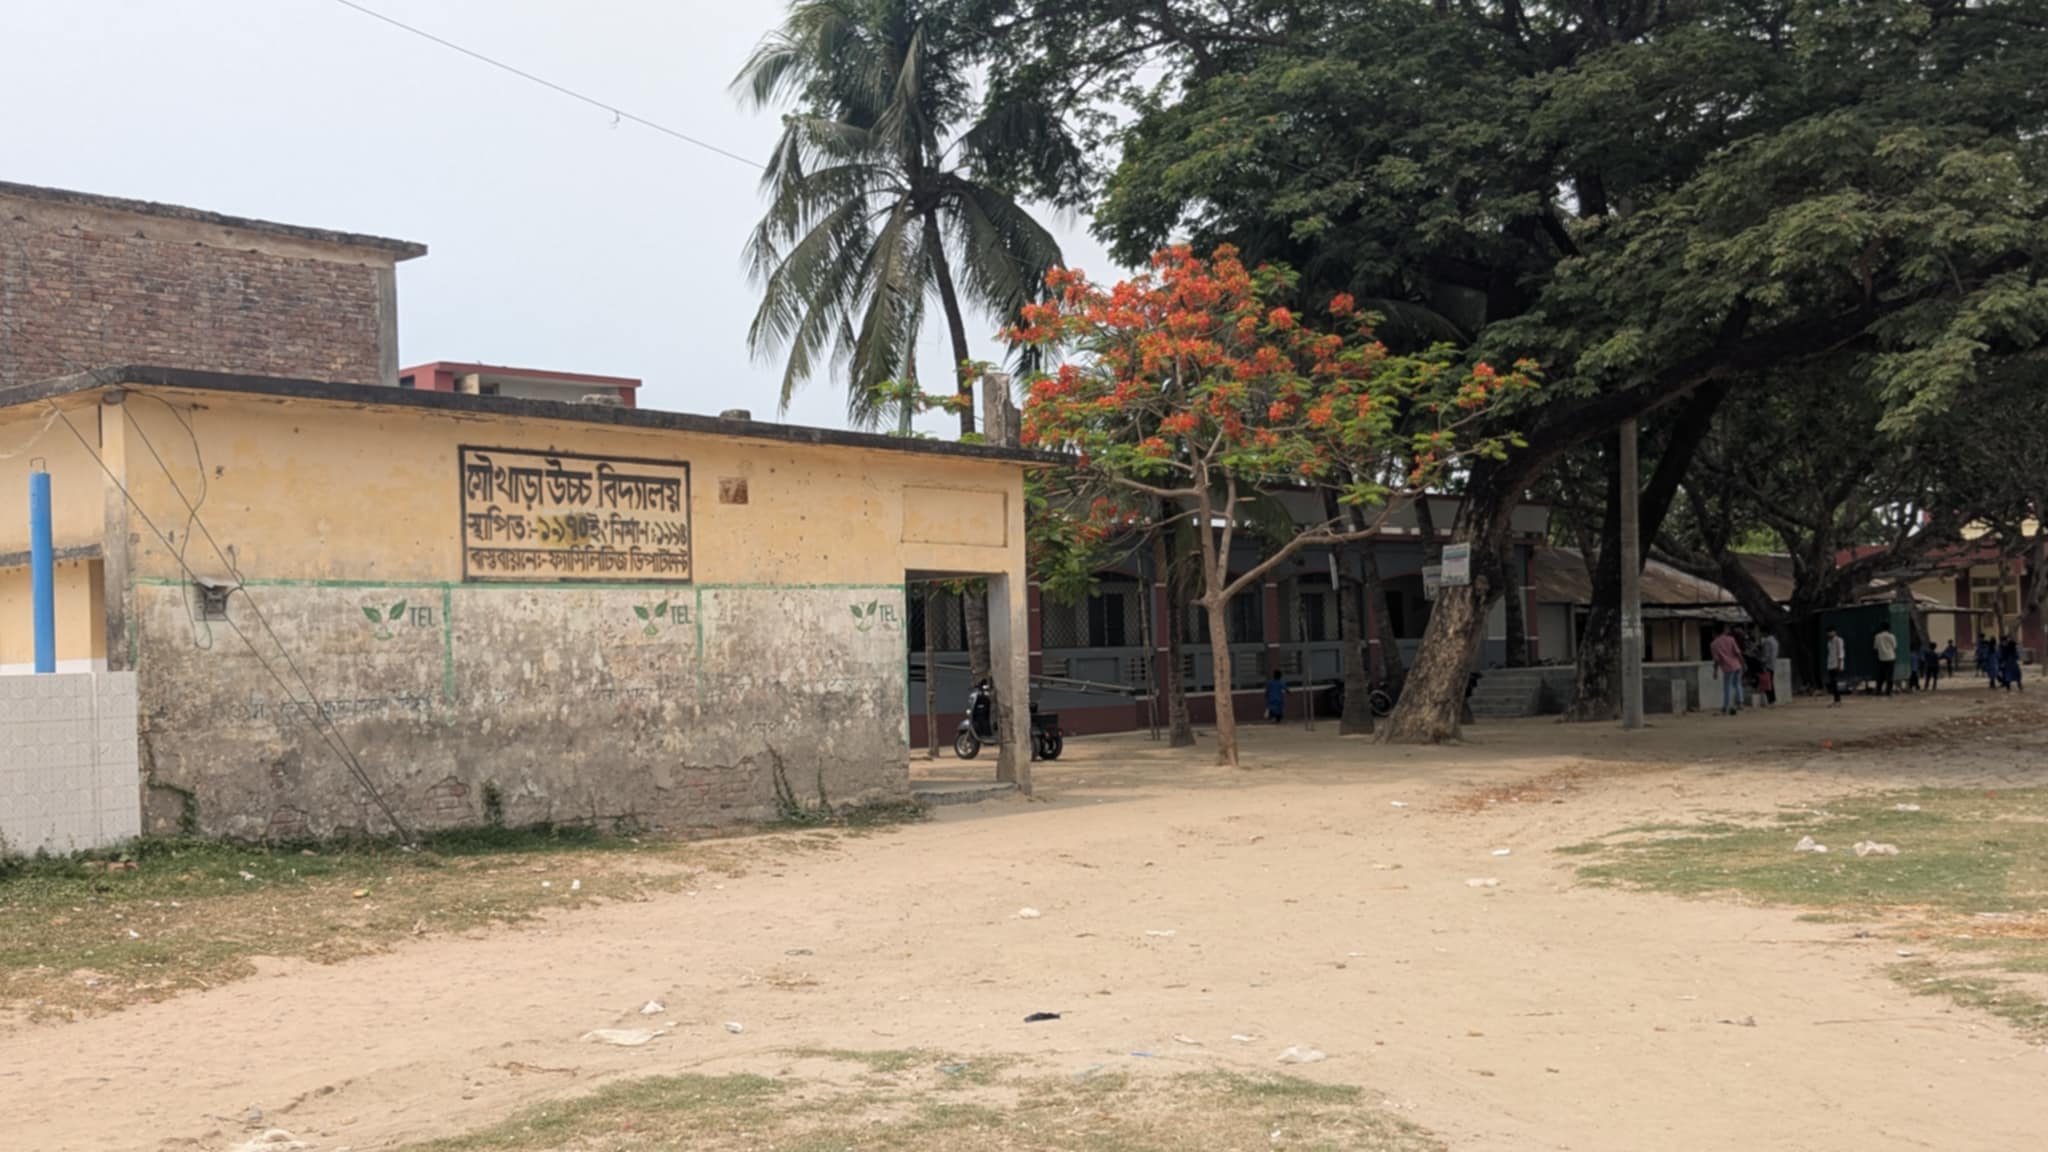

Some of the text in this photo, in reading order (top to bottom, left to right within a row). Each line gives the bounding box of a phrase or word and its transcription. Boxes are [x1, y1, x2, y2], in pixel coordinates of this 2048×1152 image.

[545, 458, 592, 506] উচ্চ
[597, 463, 681, 512] বিদ্যালয়
[408, 606, 436, 627] TEL
[671, 604, 693, 625] TEL
[879, 604, 898, 622] TEL
